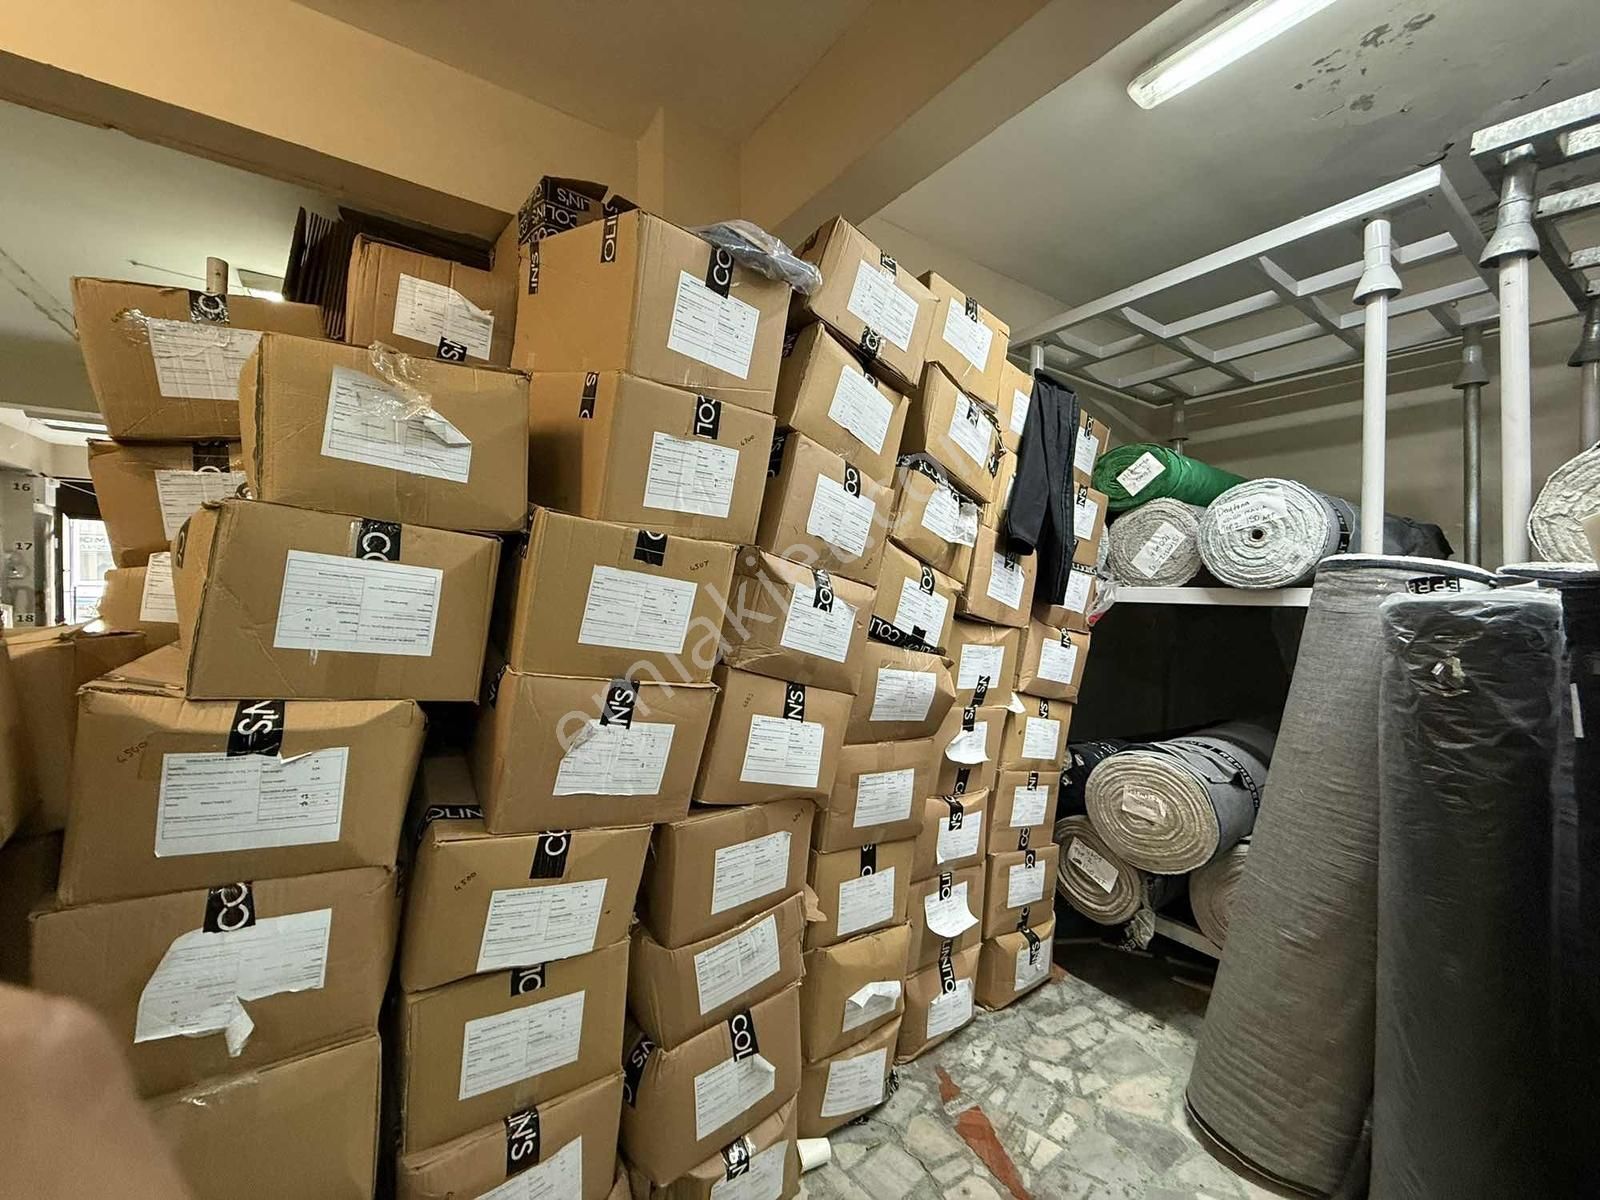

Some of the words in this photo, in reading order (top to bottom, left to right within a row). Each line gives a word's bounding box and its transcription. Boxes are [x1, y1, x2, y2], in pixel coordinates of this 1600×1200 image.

[13, 482, 31, 491] 16
[15, 542, 32, 551] 17
[16, 614, 34, 623] 18
